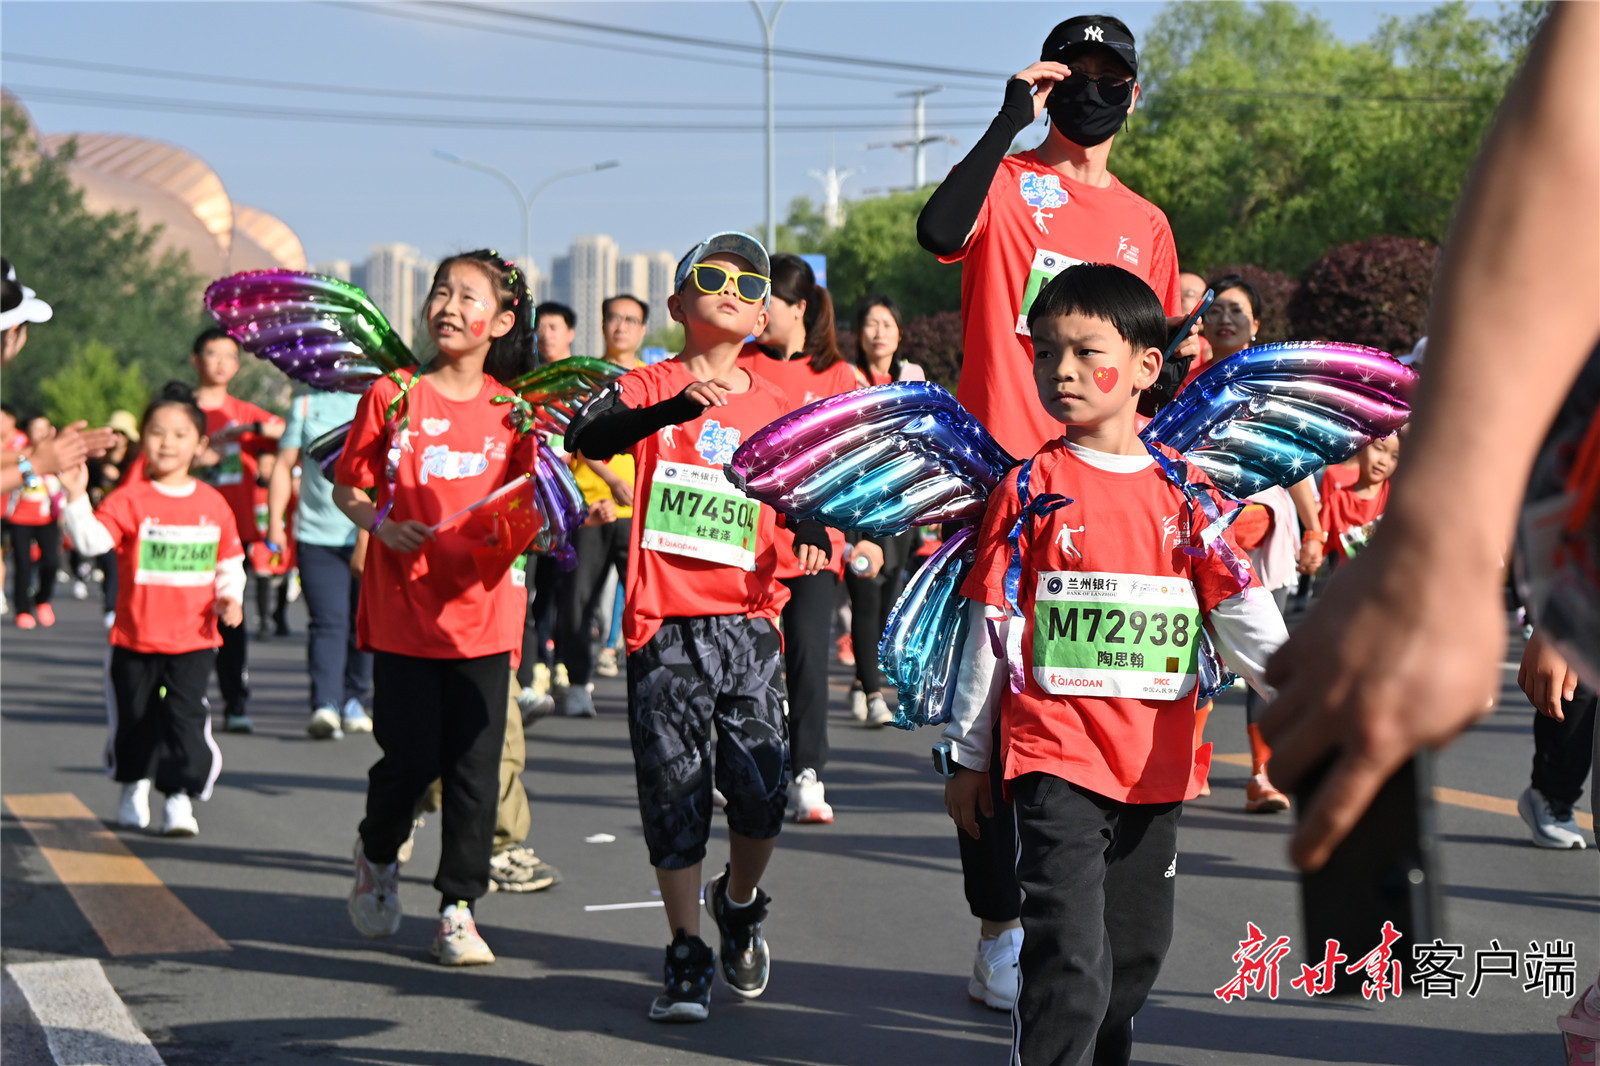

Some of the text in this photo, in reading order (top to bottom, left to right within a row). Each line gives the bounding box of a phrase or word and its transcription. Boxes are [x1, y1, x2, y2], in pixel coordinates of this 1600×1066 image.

[681, 469, 719, 483] 兰州银行
[660, 487, 754, 532] M74504
[665, 540, 698, 552] QIAODAN
[1067, 577, 1118, 592] 兰州银行
[1048, 607, 1189, 647] M72938
[1097, 650, 1144, 669] 陶思翰
[1058, 678, 1103, 689] QIAODAN
[1154, 678, 1171, 686] PICC
